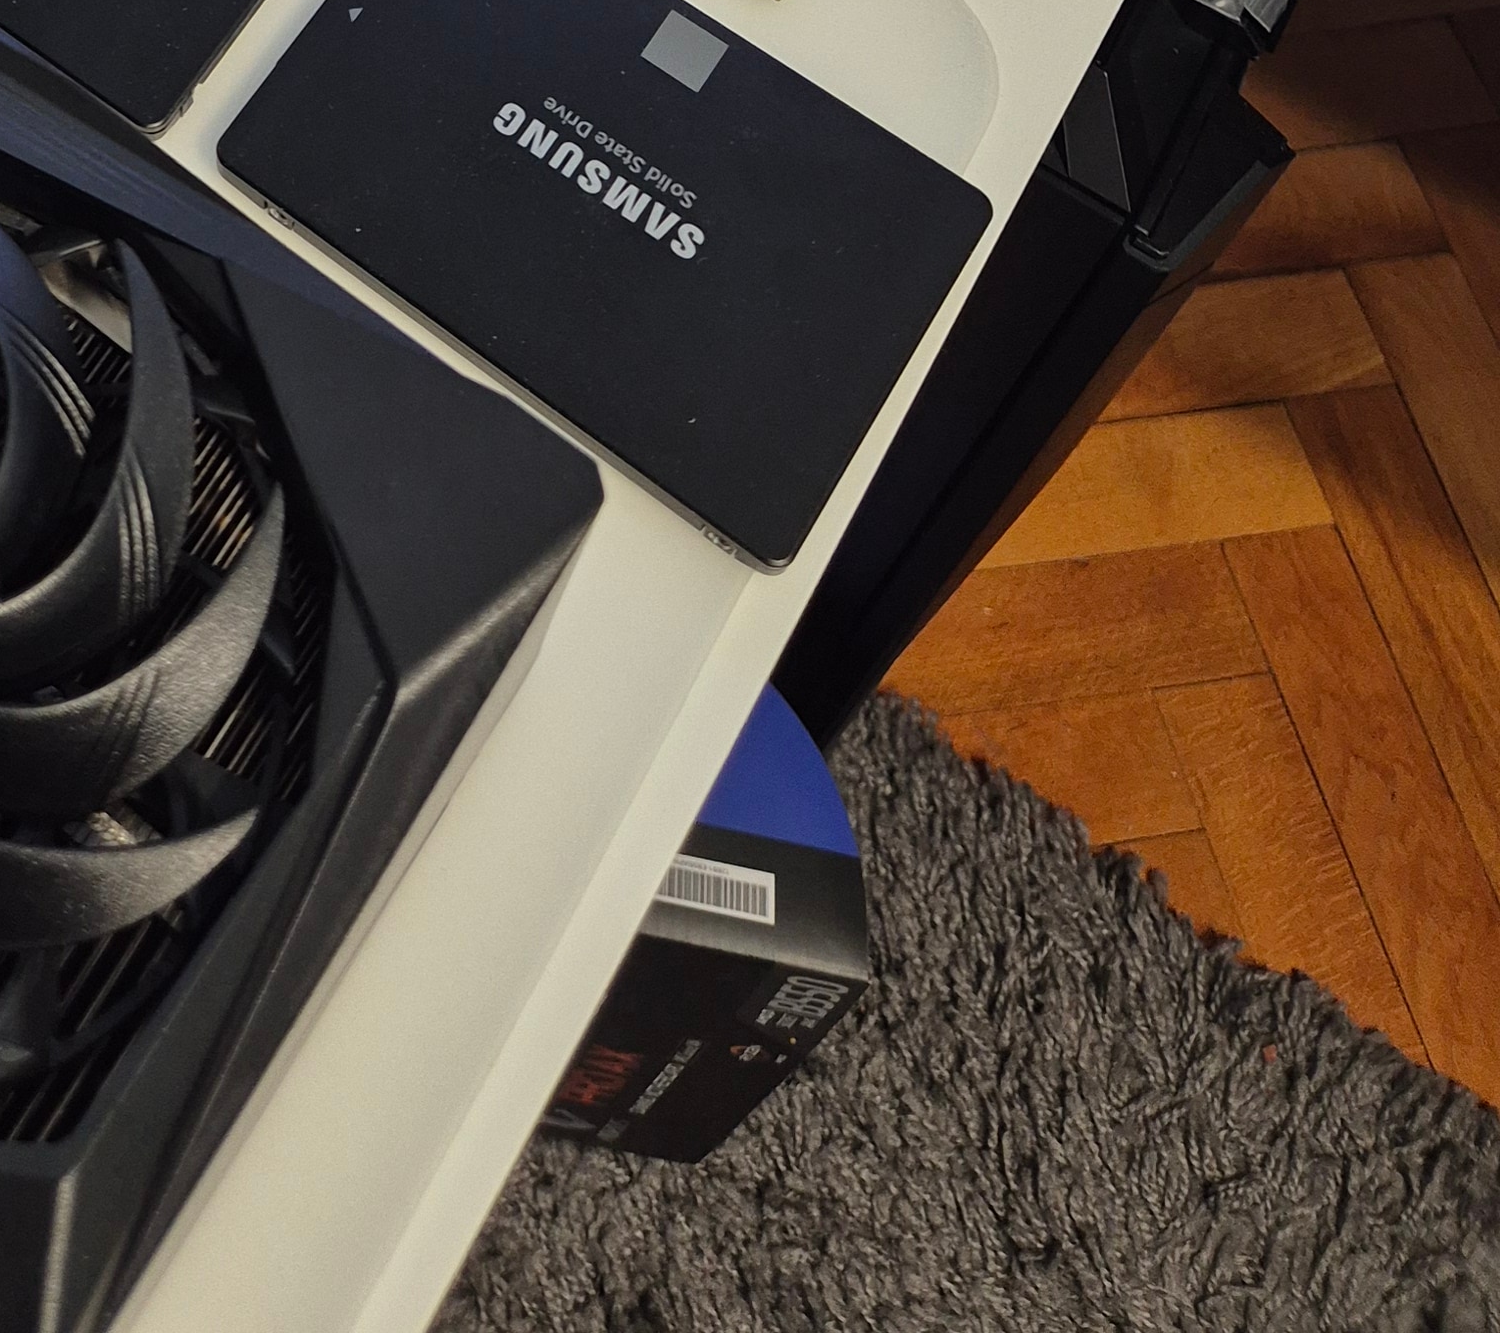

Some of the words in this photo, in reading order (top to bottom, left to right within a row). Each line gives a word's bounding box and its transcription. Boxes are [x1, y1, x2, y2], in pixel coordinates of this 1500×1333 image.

[543, 96, 594, 139] Drive
[594, 131, 647, 174] State
[492, 102, 705, 260] SAMSUNG
[643, 166, 697, 209] Solid
